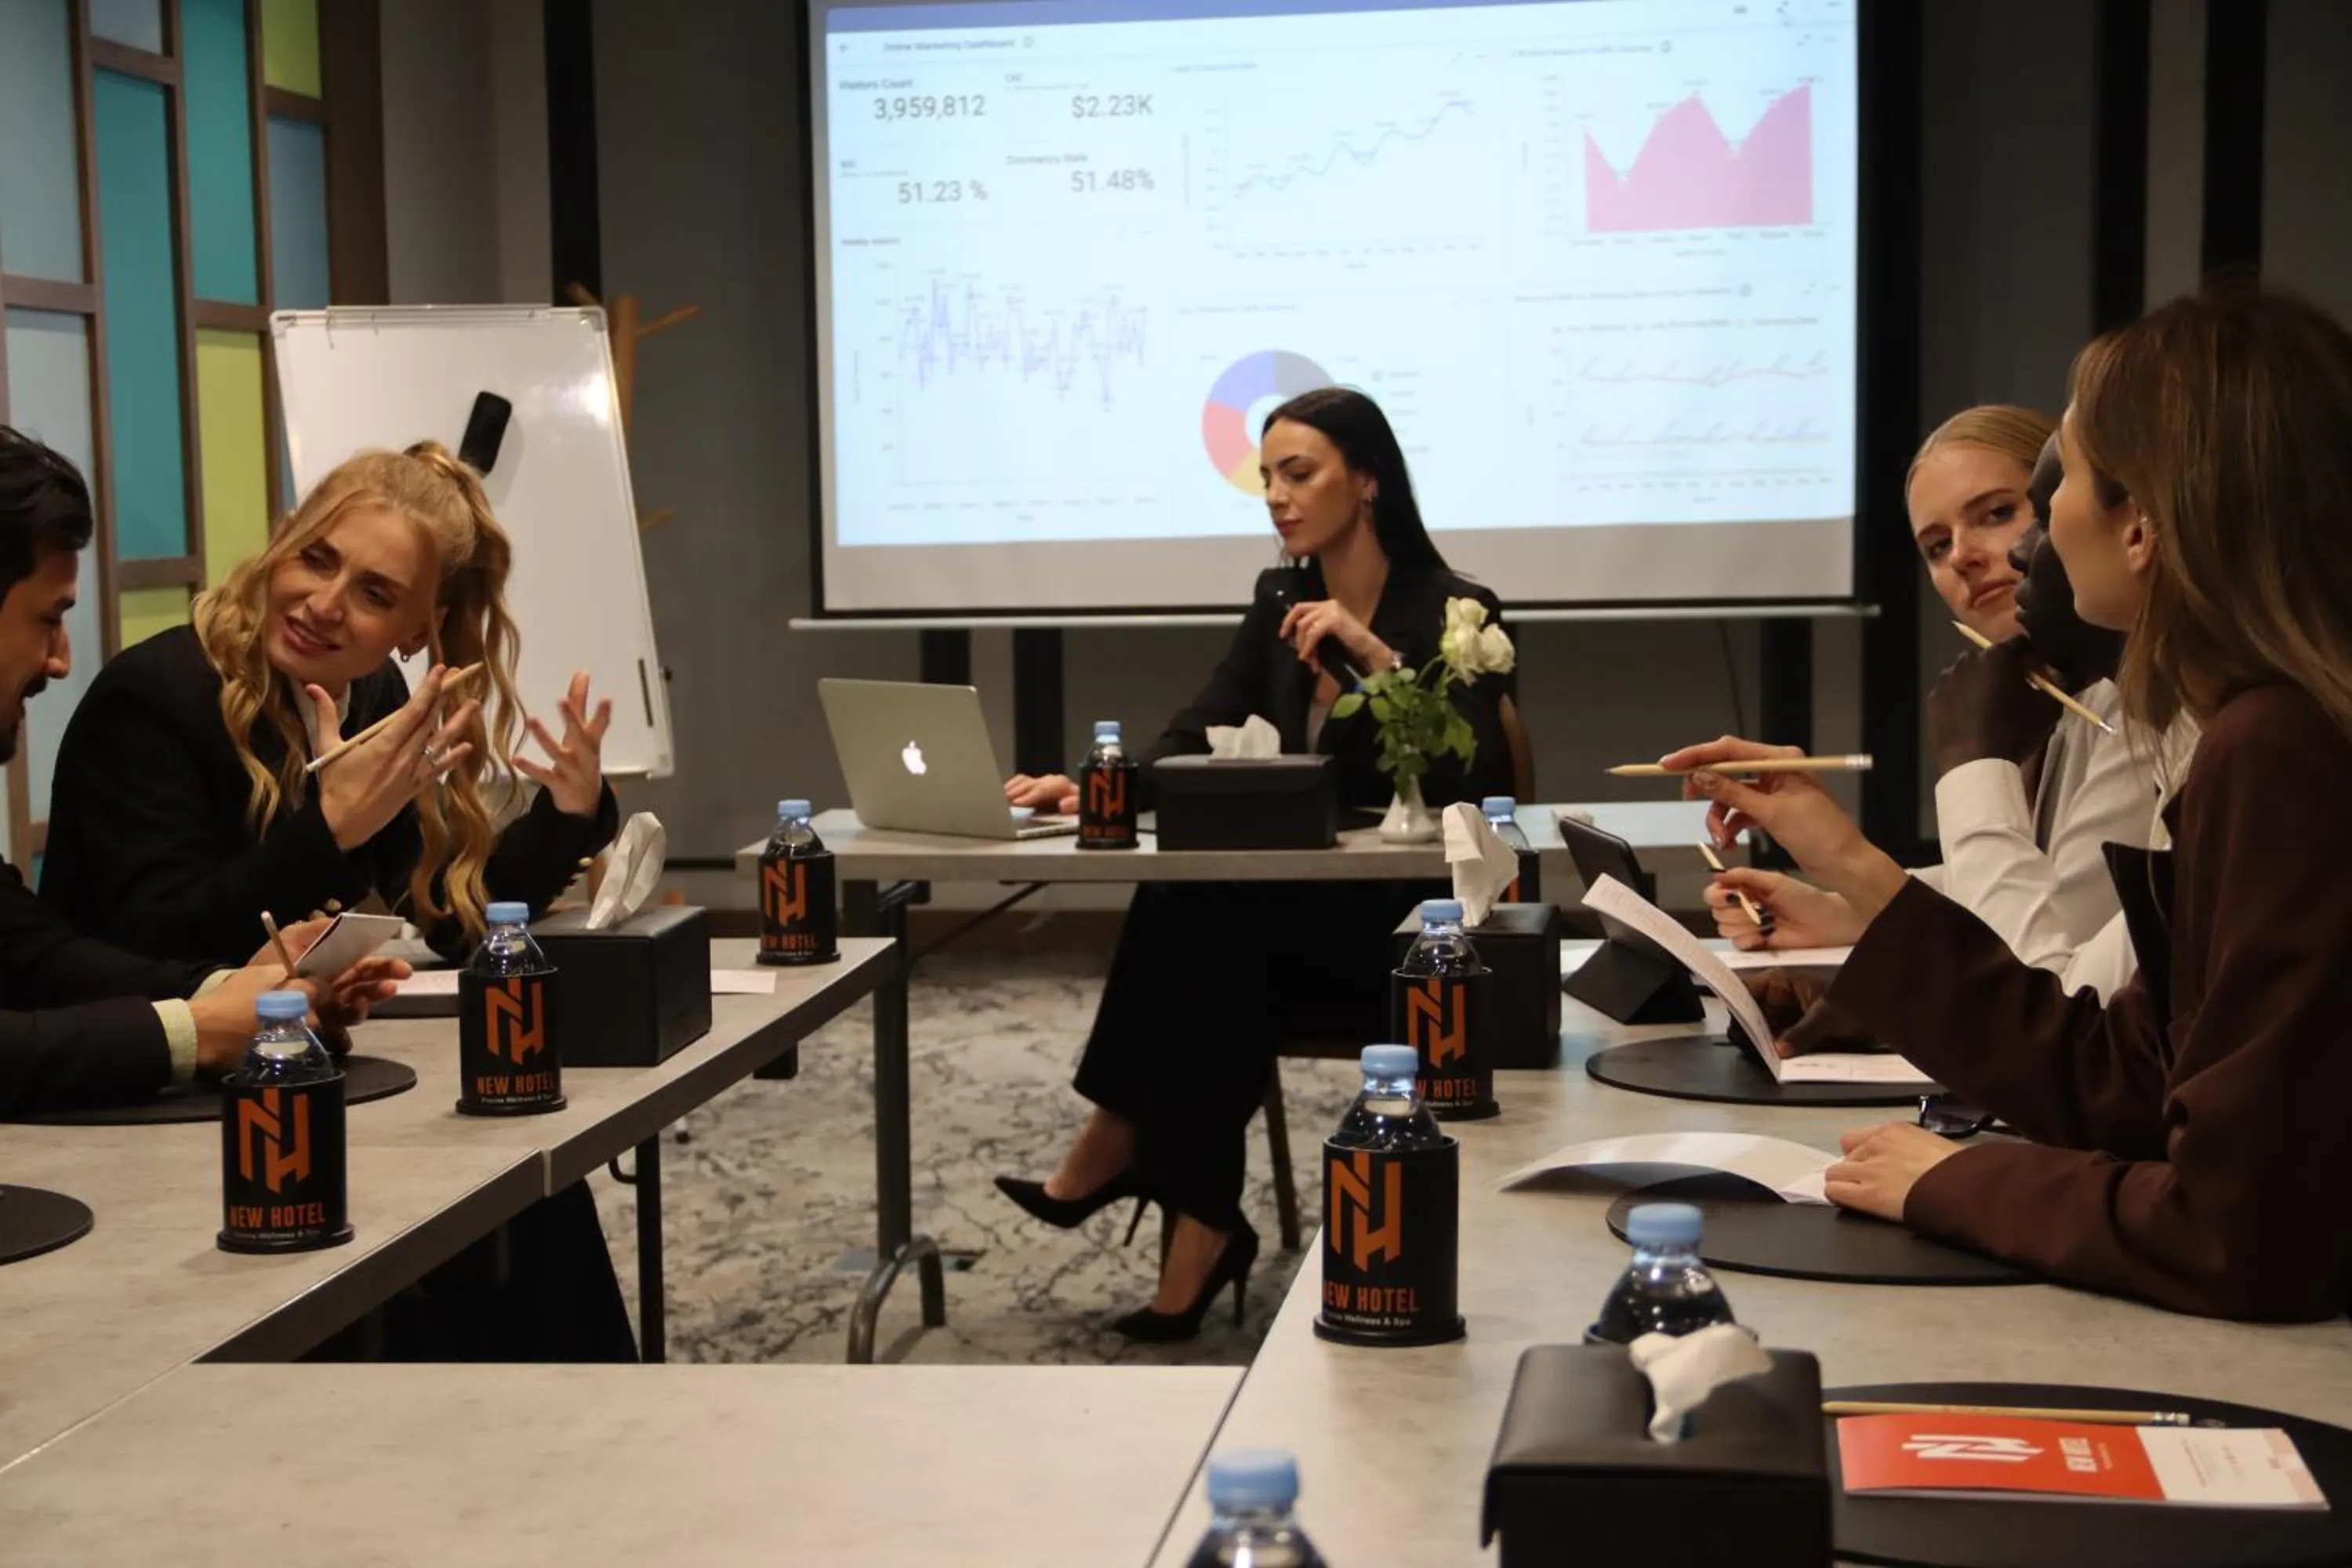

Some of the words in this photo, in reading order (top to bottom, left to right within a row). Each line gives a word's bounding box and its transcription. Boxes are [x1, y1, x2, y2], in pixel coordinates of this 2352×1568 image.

[873, 95, 986, 122] 3,959,812
[1071, 93, 1154, 119] $2.23K
[898, 180, 962, 204] 51.23
[477, 1076, 509, 1096] NEW
[270, 1201, 327, 1229] HOTEL
[1356, 1285, 1421, 1313] HOTEL
